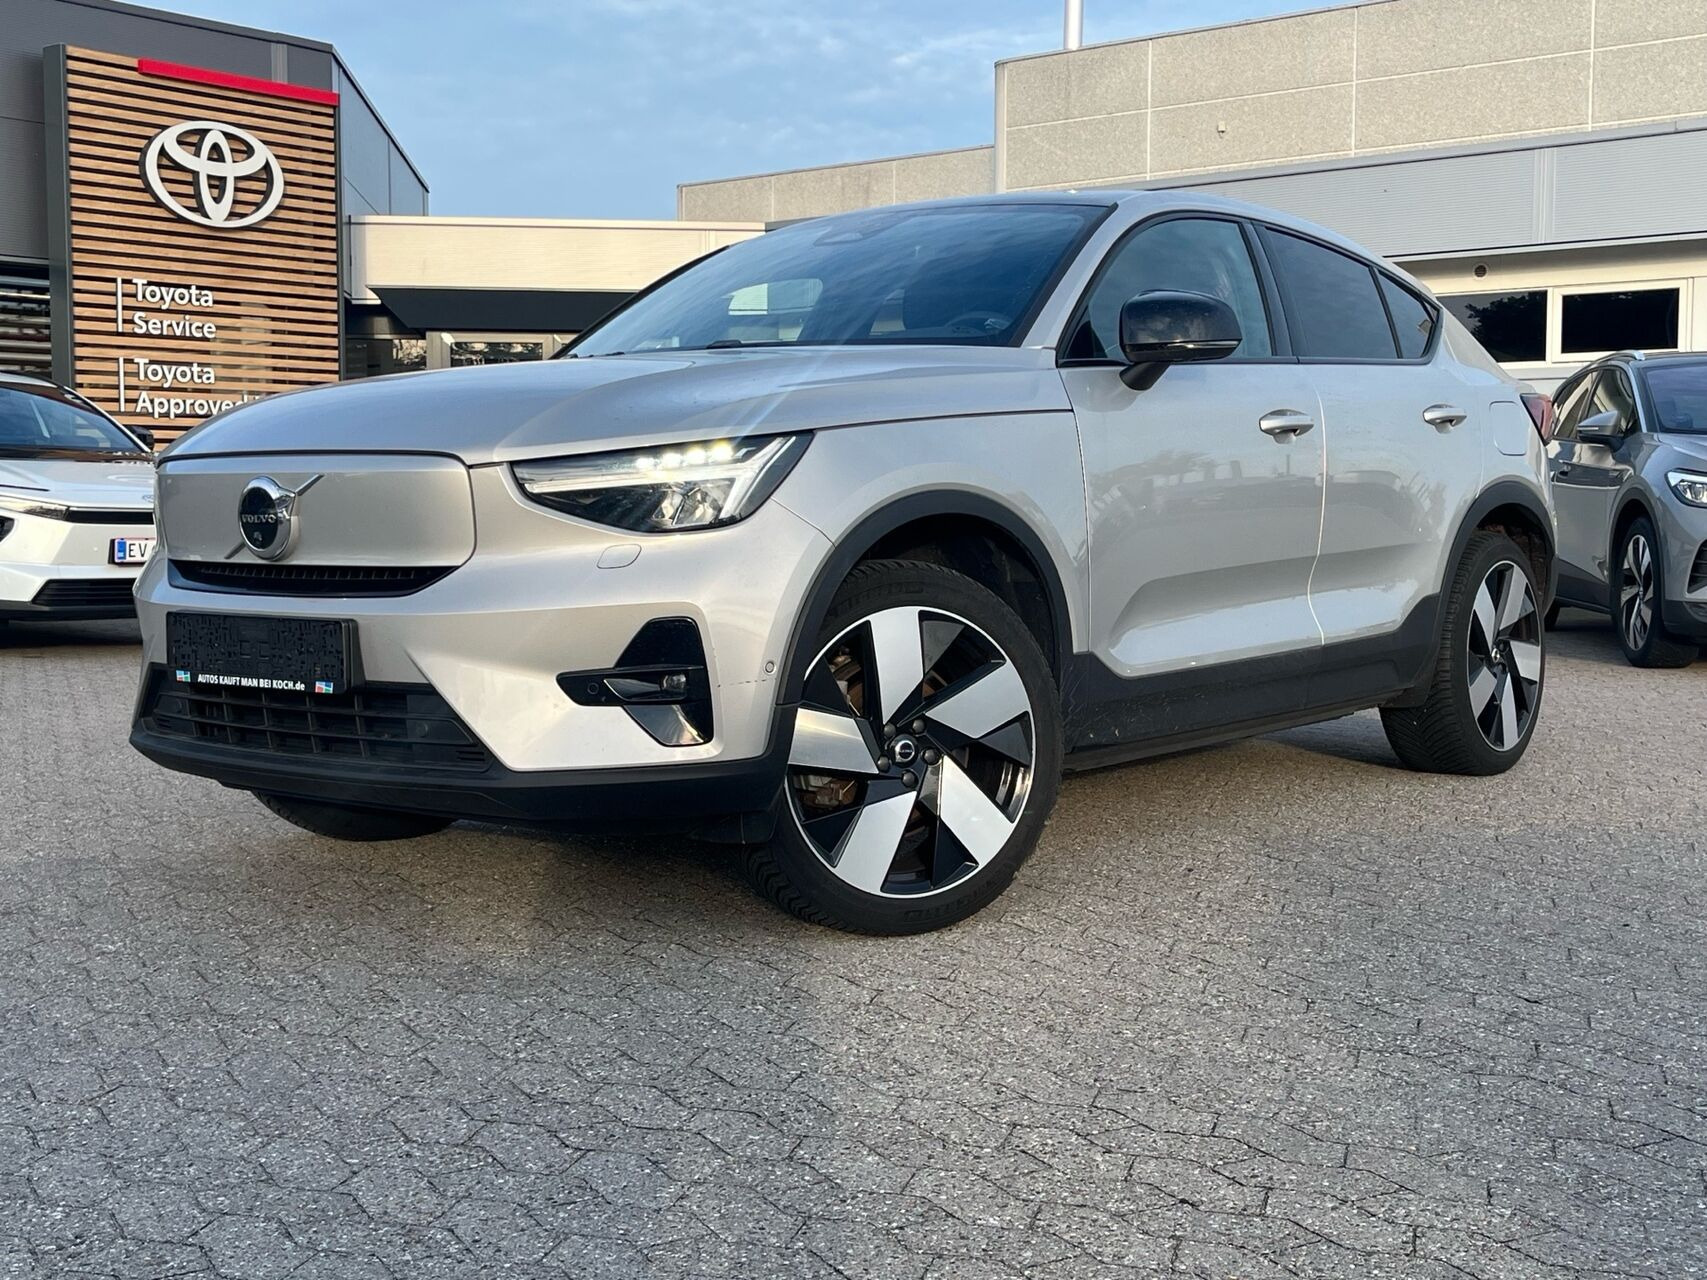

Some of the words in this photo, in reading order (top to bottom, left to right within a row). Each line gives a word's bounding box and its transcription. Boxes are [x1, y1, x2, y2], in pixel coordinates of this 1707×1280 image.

[132, 278, 213, 309] Toyota
[133, 312, 216, 338] Service
[134, 357, 215, 388] Toyota
[241, 513, 277, 523] VOLVO
[197, 674, 218, 684] AUTOS
[219, 675, 240, 686] KAUFT
[241, 677, 258, 687] MAN
[259, 679, 271, 688] BEI
[272, 679, 305, 691] KOCH.de
